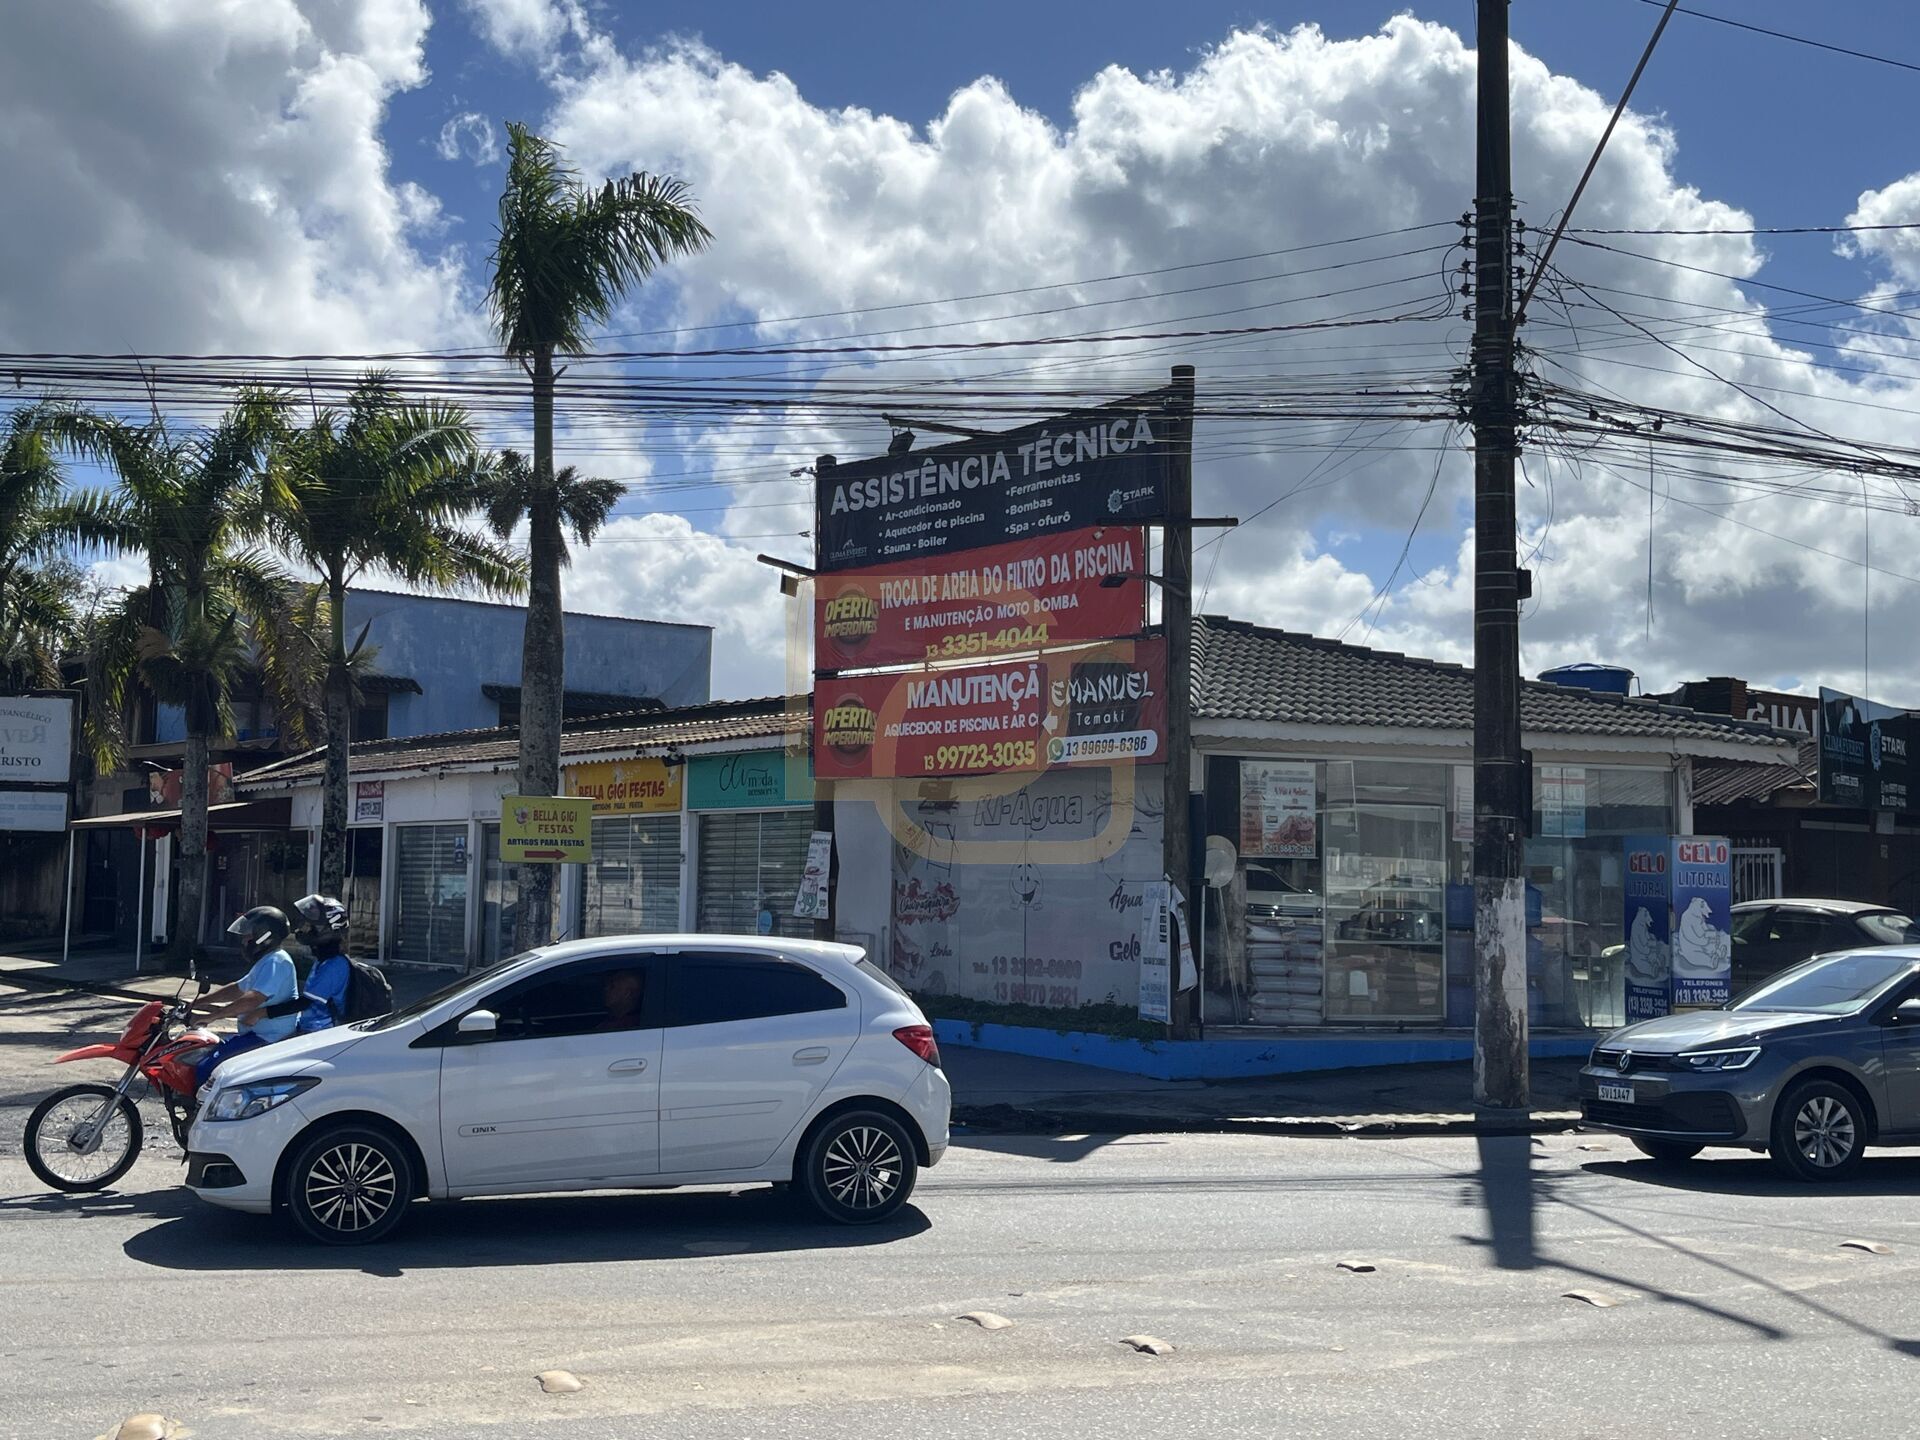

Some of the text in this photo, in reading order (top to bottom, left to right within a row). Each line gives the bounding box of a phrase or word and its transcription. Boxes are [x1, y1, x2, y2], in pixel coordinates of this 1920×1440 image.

[830, 413, 1155, 515] ASSISTÊNCIA TÉCNICA
[1010, 471, 1081, 497] Ferramentas
[1122, 485, 1155, 501] STARK
[885, 500, 962, 521] Ar-condicionado
[1010, 497, 1053, 515] Bombas
[885, 512, 985, 538] Aquecedor de piscina
[1009, 521, 1027, 535] Spa
[1038, 511, 1071, 527] ofurô
[884, 542, 911, 555] Sauna
[918, 536, 947, 548] Boiler
[880, 541, 1133, 609] TROCA DE AREIA DO FILTRO DA PISCINA
[824, 598, 879, 622] OFERTAS
[905, 593, 1079, 631] E MANUTENÇÃO MOTO BOMBA
[824, 618, 877, 638] IMPERDÍVEIS
[925, 623, 1049, 658] 13 3351-4044
[1051, 671, 1154, 707] EMANUEL
[823, 706, 877, 730] OFERTAS
[884, 712, 1039, 737] AQUECEDOR DE PISCINA E AR C
[1076, 710, 1125, 726] Temaki
[823, 729, 876, 746] IMPERDÍVEIS
[1066, 736, 1148, 756] 13 99699-6386
[1881, 735, 1907, 756] STARK
[924, 740, 1036, 770] 13 99723-3035
[579, 780, 665, 800] BELLA GIGI FESTAS
[533, 810, 578, 822] BELLA GIGI
[538, 824, 575, 834] FESTAS
[507, 838, 539, 846] ARTIGOS
[560, 839, 585, 847] FESTAS
[1678, 842, 1728, 864] GELO
[1629, 852, 1665, 873] GELO
[1629, 879, 1667, 898] LITORAL
[1678, 870, 1728, 888] LITORAL
[1109, 880, 1144, 913] Água
[1109, 933, 1141, 961] Gelo
[1712, 989, 1728, 998] 3434
